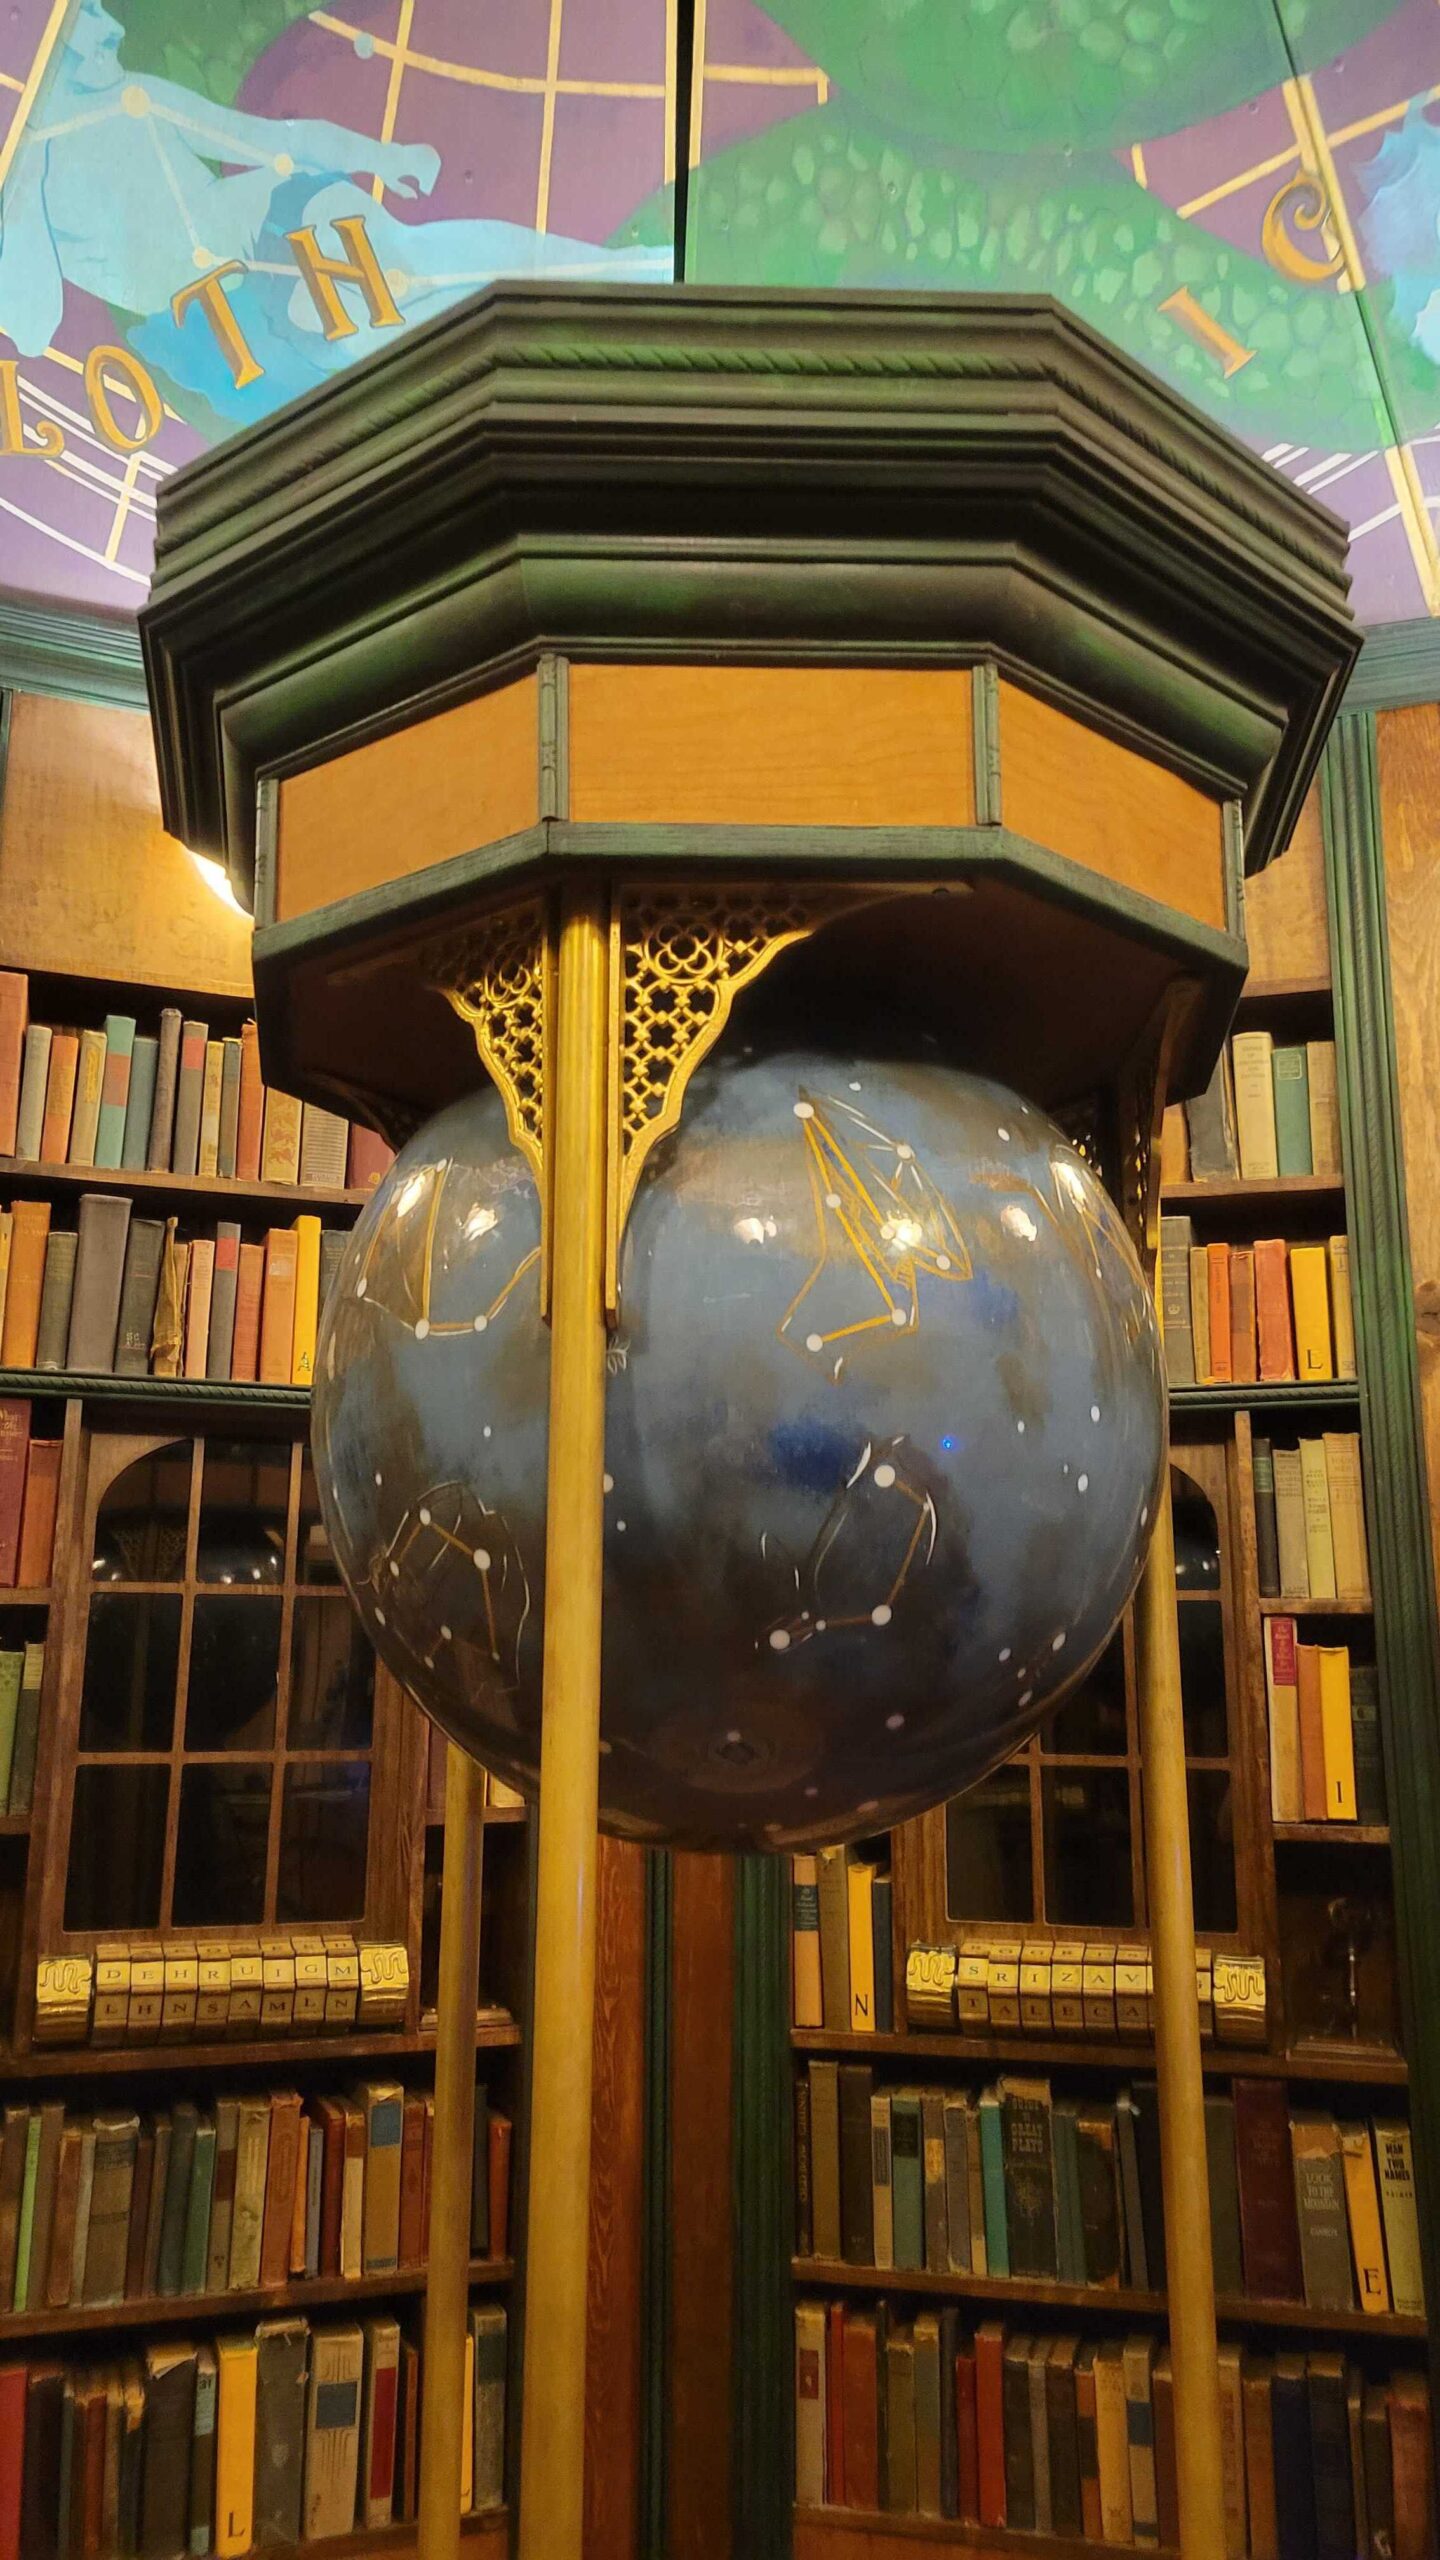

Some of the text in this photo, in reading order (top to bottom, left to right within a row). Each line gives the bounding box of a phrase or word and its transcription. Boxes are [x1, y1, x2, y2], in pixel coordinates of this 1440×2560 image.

[1306, 1348, 1324, 1370] L
[854, 1992, 869, 2017] N
[1363, 2267, 1382, 2295] E
[228, 2511, 246, 2538] L
